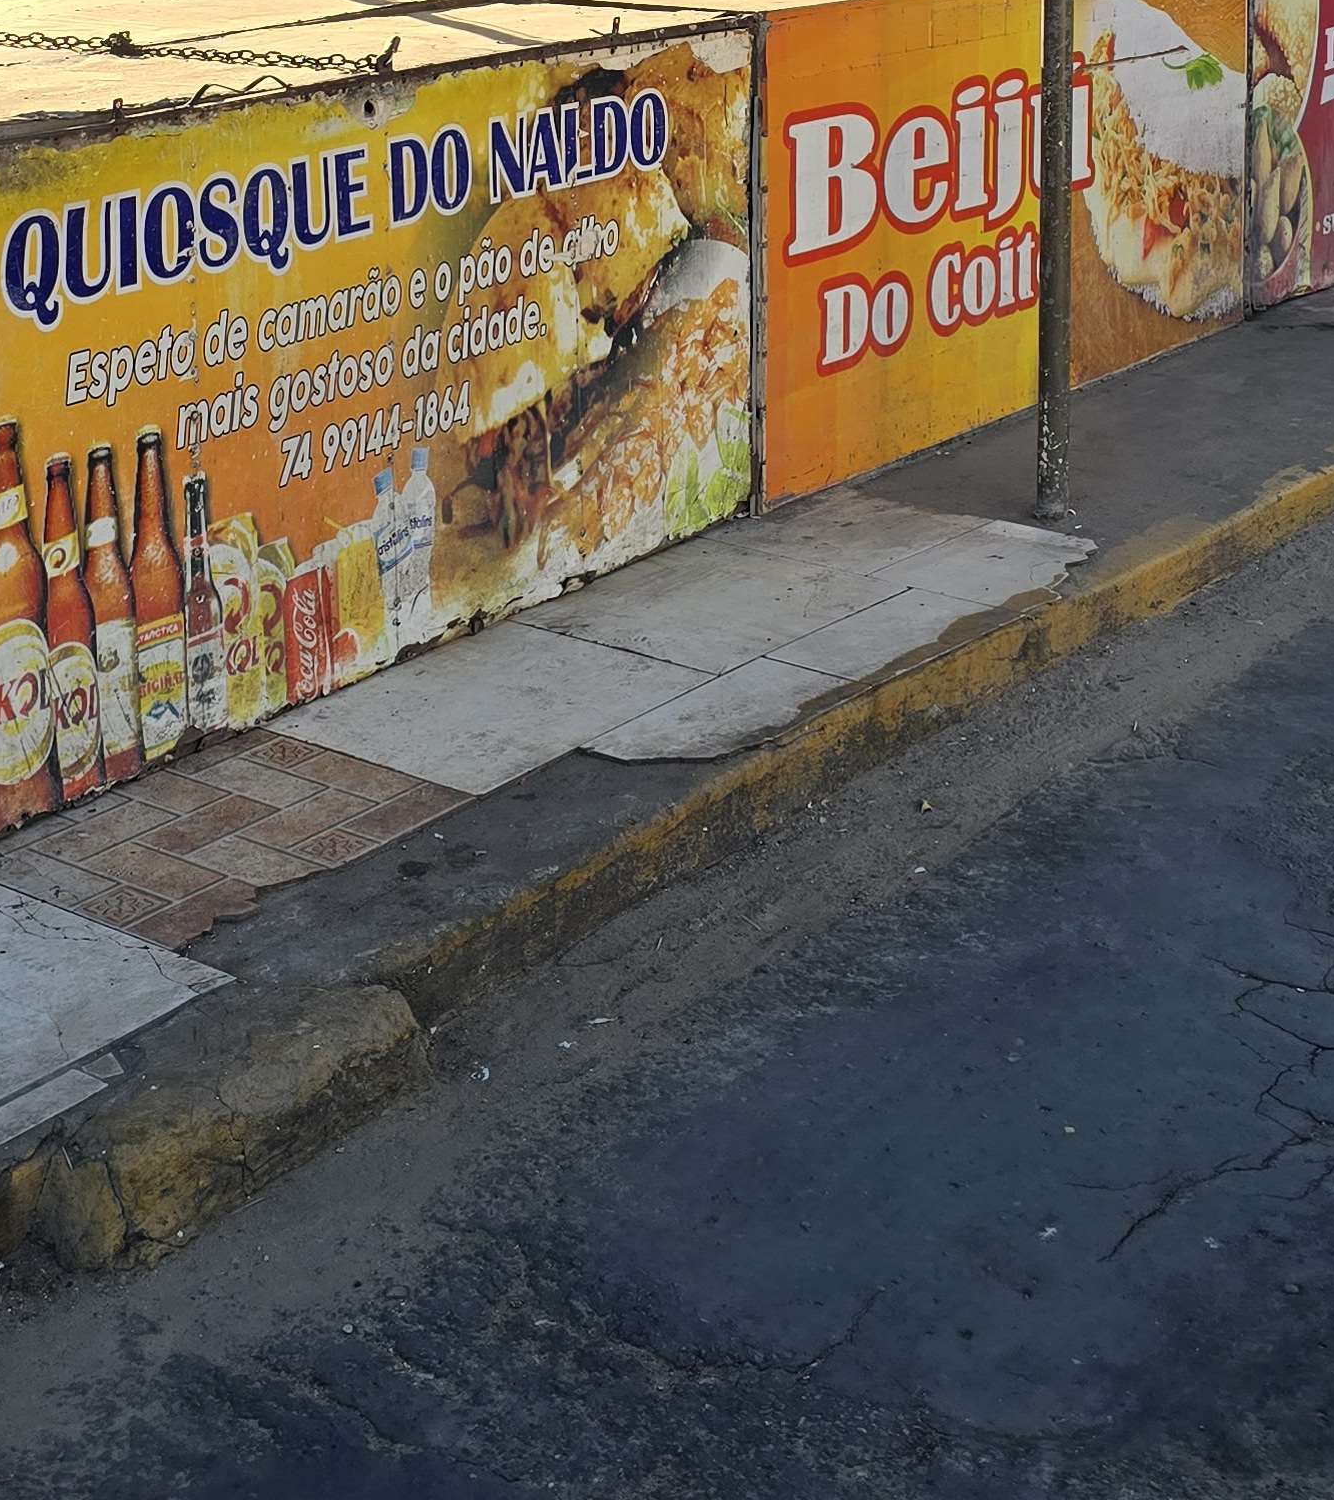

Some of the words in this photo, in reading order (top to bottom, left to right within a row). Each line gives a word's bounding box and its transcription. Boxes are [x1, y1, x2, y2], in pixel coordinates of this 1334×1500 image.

[3, 148, 370, 327] QUIOSQUE
[391, 126, 470, 223] DO
[490, 89, 667, 199] NALDO
[67, 327, 196, 407] Espeto
[204, 308, 248, 371] de
[257, 268, 402, 350] camarão
[408, 272, 427, 304] e
[434, 268, 453, 302] o
[456, 235, 512, 306] pão
[520, 228, 554, 279] de
[175, 372, 259, 452] mais
[269, 343, 395, 431] gostoso
[402, 324, 442, 381] da
[447, 297, 548, 366] cidade.
[822, 282, 908, 367] Do
[932, 232, 1040, 327] Coit
[280, 434, 313, 488] 74
[322, 381, 471, 474] 99144-1864
